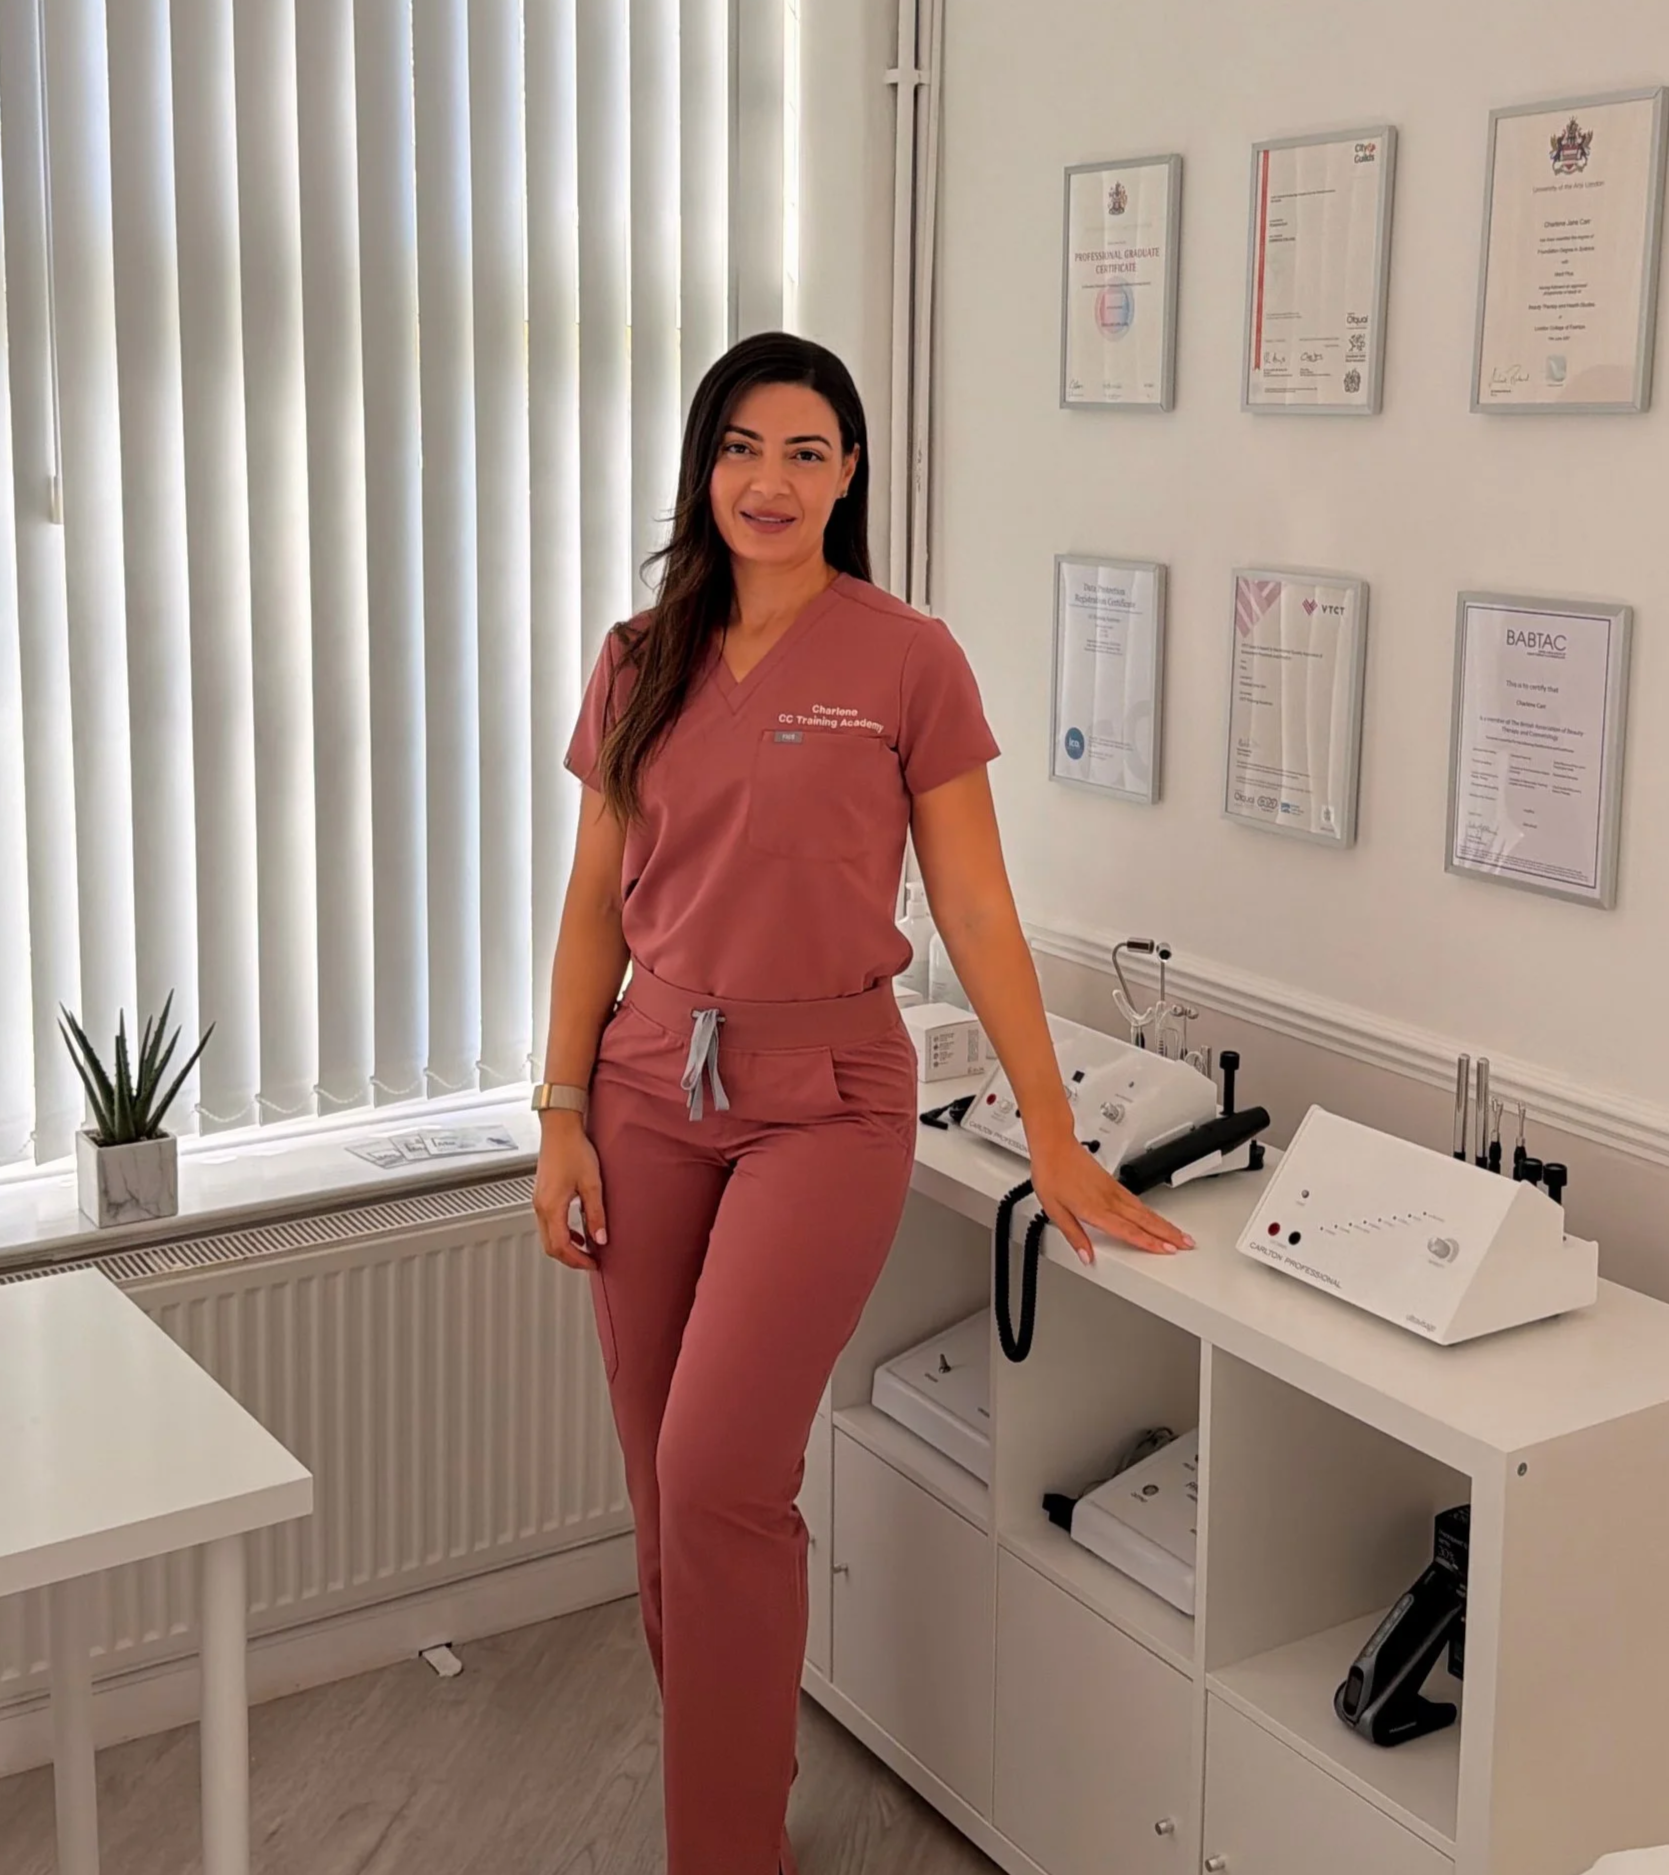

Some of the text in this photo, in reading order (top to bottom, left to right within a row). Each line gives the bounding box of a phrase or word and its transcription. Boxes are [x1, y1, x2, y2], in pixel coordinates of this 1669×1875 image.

[1585, 181, 1604, 189] London
[1074, 247, 1160, 262] PROFESSIONAL GRADUATE
[1095, 262, 1137, 274] CERTIFICATE
[1321, 604, 1345, 616] VTCT
[1506, 629, 1567, 652] BABTAC
[1506, 680, 1517, 688] This
[1517, 681, 1522, 689] is
[1529, 684, 1546, 693] certify
[1547, 686, 1559, 694] that
[812, 704, 858, 717] Charlene
[778, 713, 884, 734] CC Training Academy
[969, 1120, 993, 1136] CARLTON
[1249, 1241, 1343, 1290] CARLTON PROFESSIONAL
